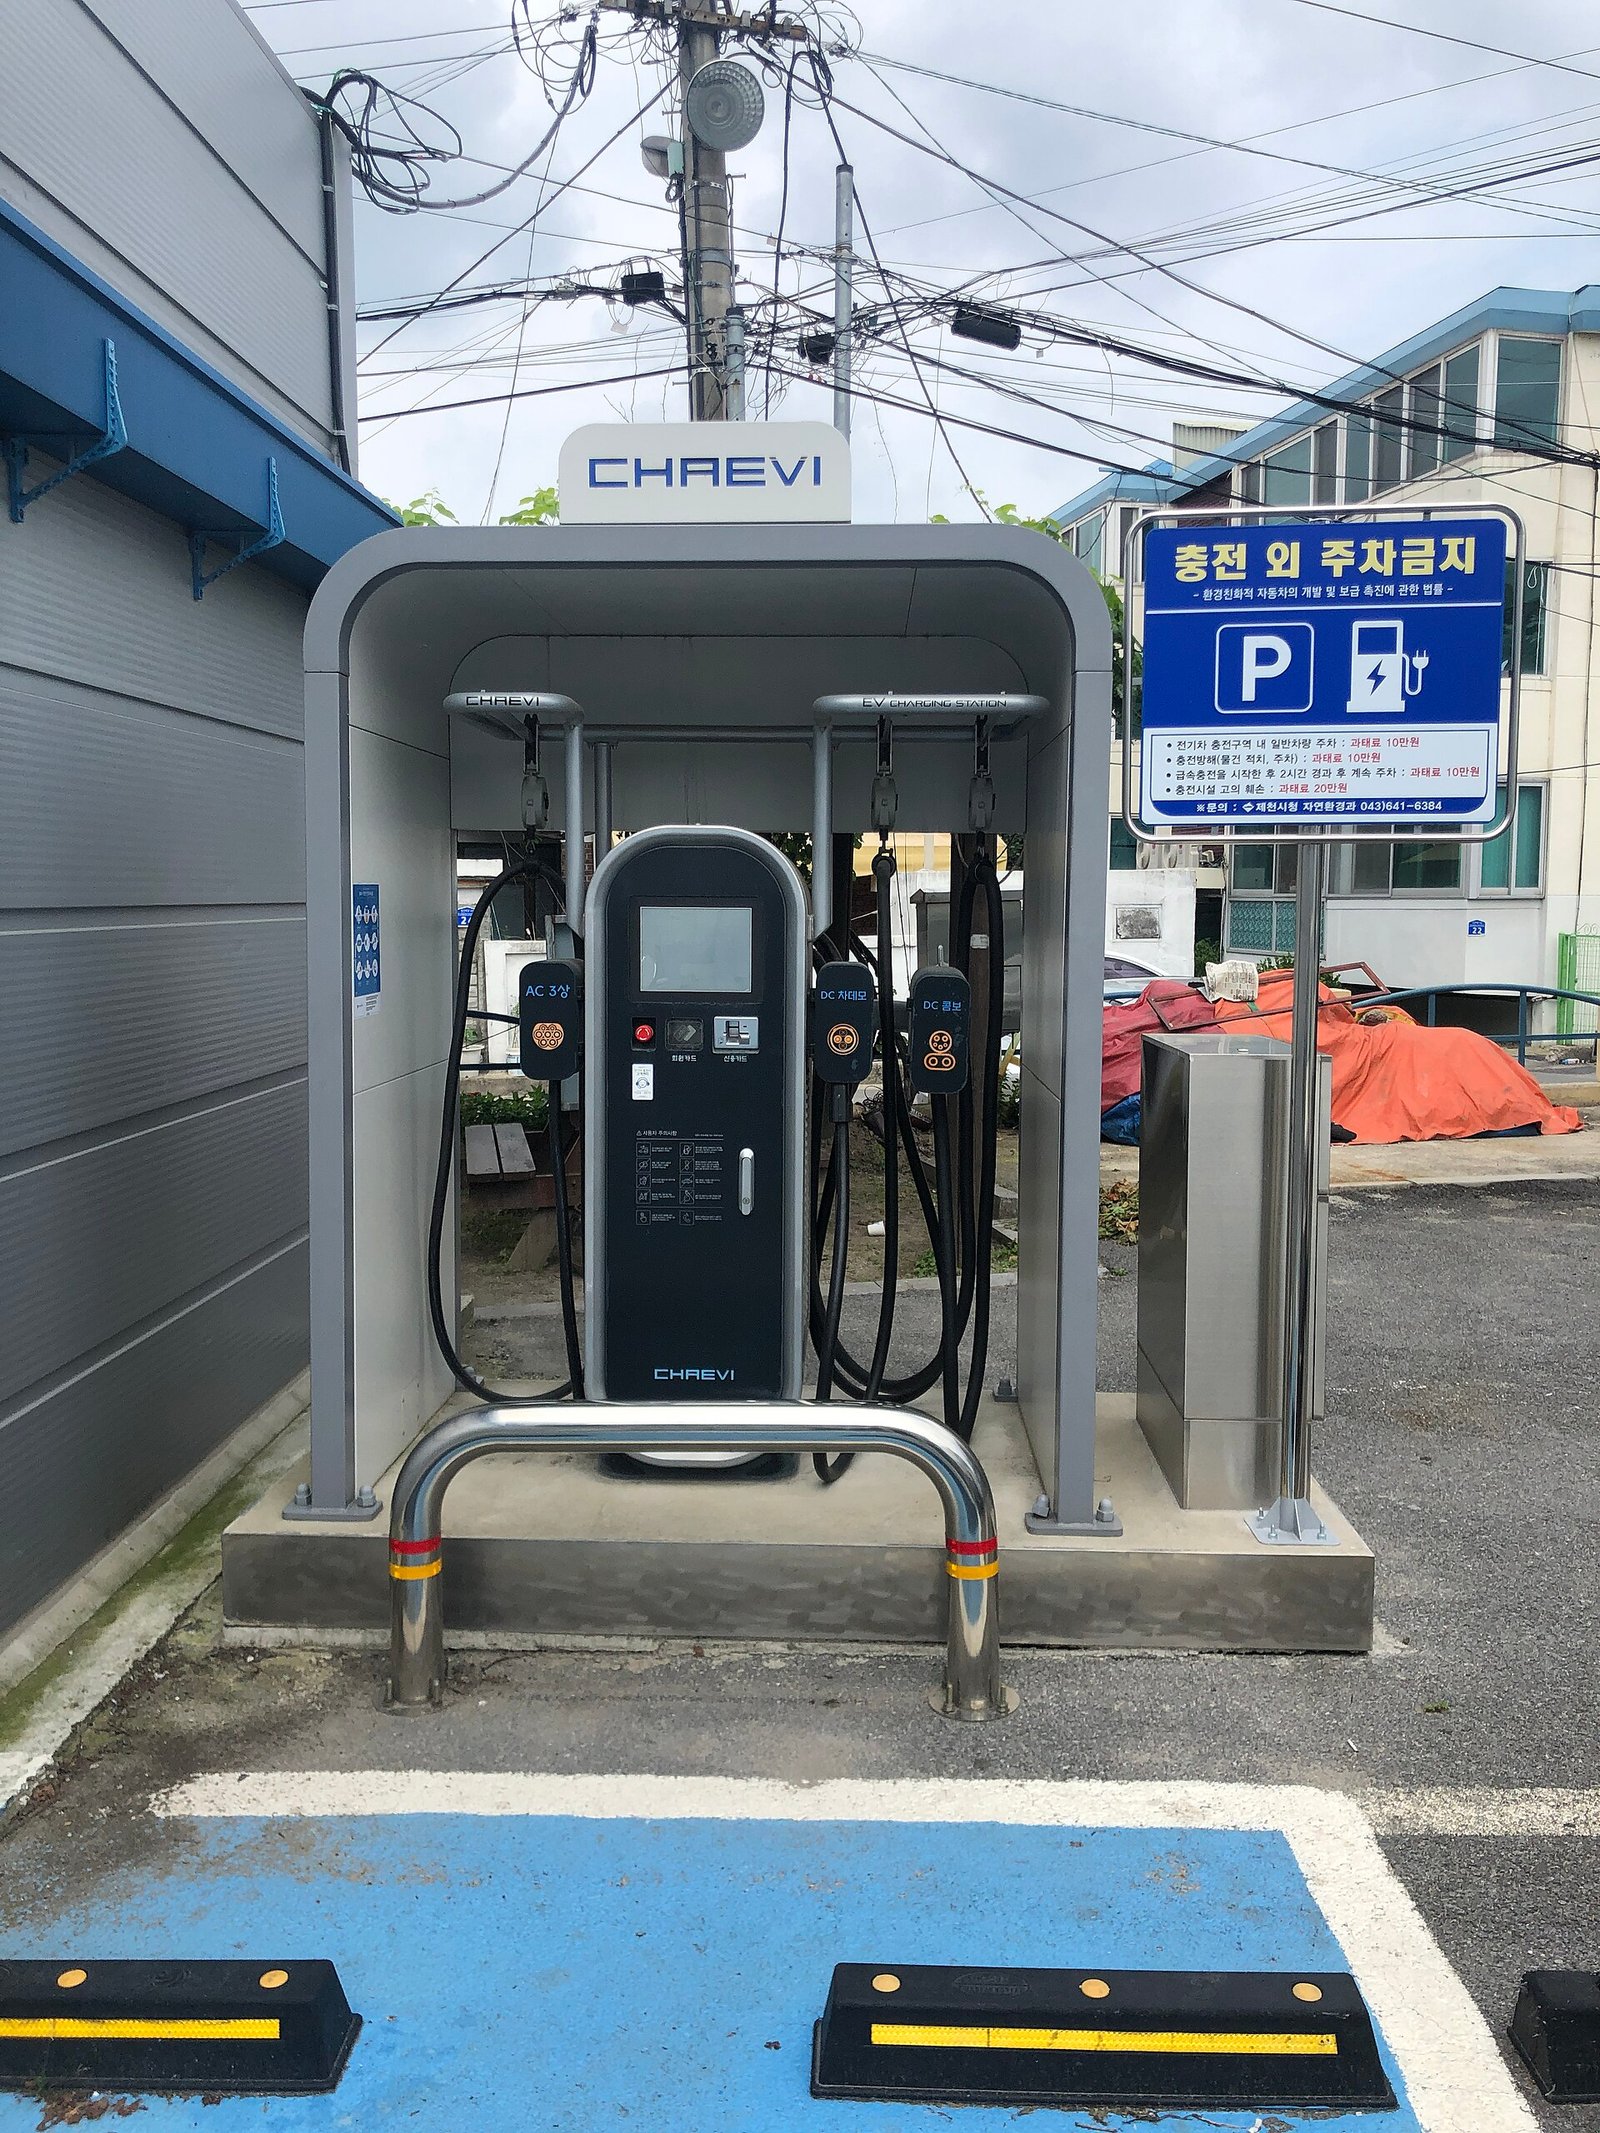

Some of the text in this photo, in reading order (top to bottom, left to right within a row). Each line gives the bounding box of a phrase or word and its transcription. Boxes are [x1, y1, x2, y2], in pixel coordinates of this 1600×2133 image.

[588, 456, 821, 488] CHAEVI
[1174, 537, 1476, 583] 충전 외 주차금지
[1202, 587, 1253, 602] 환경친화적
[1257, 586, 1297, 600] 자동차의
[1301, 585, 1322, 598] 개발
[1325, 585, 1336, 598] 및
[1339, 584, 1360, 598] 보급
[1364, 584, 1394, 598] 촉진에
[1398, 583, 1420, 596] 관한
[1422, 582, 1444, 596] 법률
[1241, 635, 1292, 702] P
[466, 696, 539, 706] CHAEVI
[862, 698, 885, 707] EV
[890, 699, 952, 707] CHARGING
[1176, 740, 1207, 750] 전기차
[1211, 740, 1252, 750] 충전구역
[1256, 739, 1266, 749] 내
[1270, 739, 1311, 749] 일반차량
[1316, 738, 1337, 748] 주차
[1350, 738, 1381, 748] 과태료
[1386, 737, 1420, 747] 10만원
[1176, 754, 1241, 766] 충전방해(물건
[1246, 754, 1269, 765] 적치,
[1274, 754, 1298, 764] 주차)
[1312, 753, 1342, 763] 과태료
[1348, 752, 1381, 762] 10만원
[1176, 770, 1226, 780] 급속충전을
[1231, 769, 1261, 780] 시작한
[1265, 769, 1276, 779] 후
[1280, 768, 1307, 778] 2시간
[1312, 768, 1332, 779] 경과
[1336, 768, 1346, 778] 후
[1351, 767, 1372, 778] 계속
[1376, 767, 1396, 778] 주차
[1410, 767, 1441, 777] 과태료
[1447, 766, 1480, 777] 10만원
[1175, 784, 1216, 795] 충전시설
[1220, 784, 1240, 794] 고의
[1245, 784, 1265, 794] 훼손
[1279, 783, 1309, 794] 과태료
[1314, 782, 1348, 793] 20만원
[1255, 801, 1298, 812] 제천시청
[1302, 802, 1356, 811] 자연환경과
[1360, 801, 1442, 811] 043)641-6384
[526, 984, 570, 998] AC 3상
[820, 990, 867, 1001] DC 차데모
[923, 1000, 961, 1012] DC 콤보
[654, 1369, 734, 1380] CHAEVI
